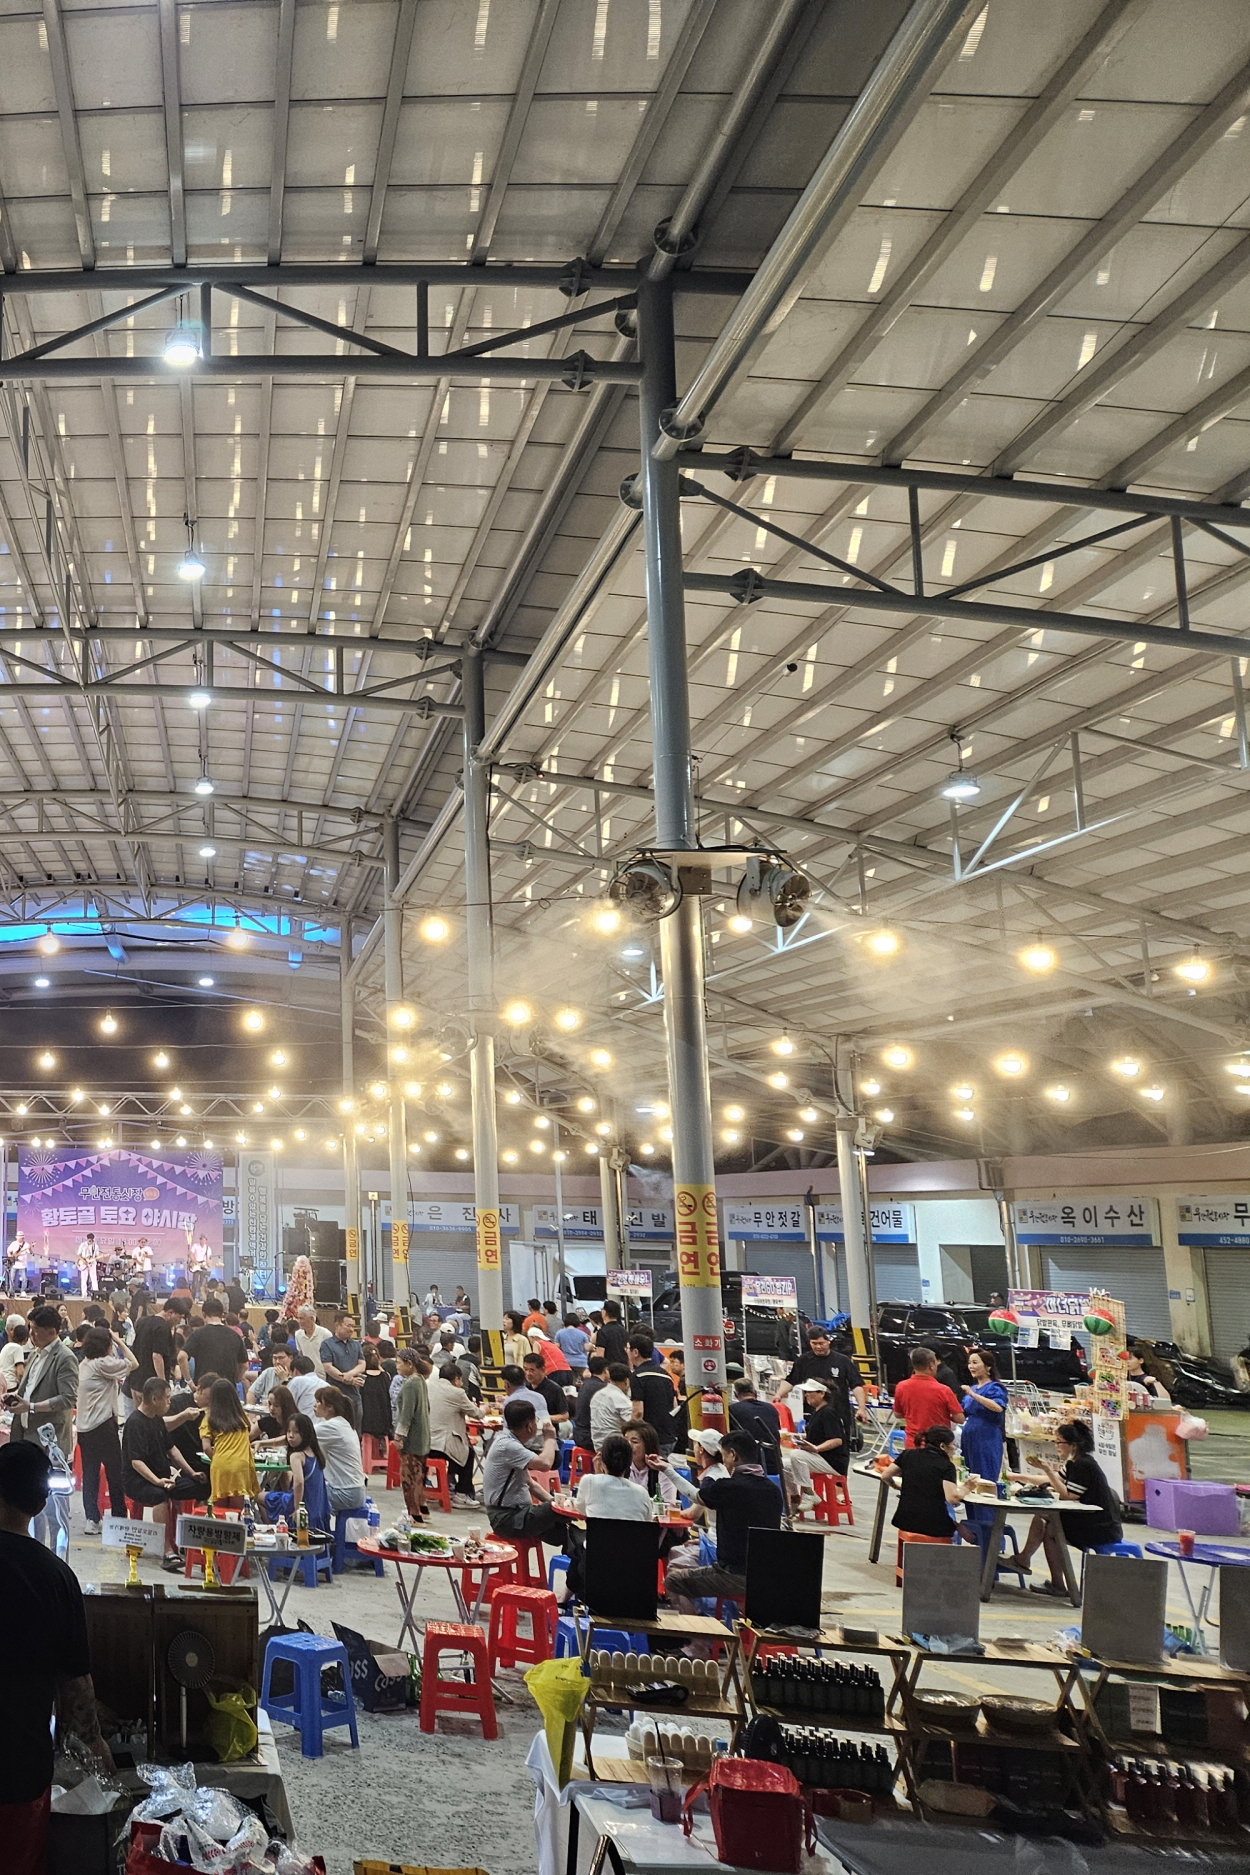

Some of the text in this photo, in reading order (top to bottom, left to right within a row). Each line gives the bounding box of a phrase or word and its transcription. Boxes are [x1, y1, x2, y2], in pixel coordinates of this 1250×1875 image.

[41, 1206, 198, 1231] 황토골 토요 야시장
[753, 1210, 801, 1229] 무안젓갈
[1060, 1204, 1145, 1228] 옥이수산
[484, 1231, 498, 1264] 금연
[678, 1221, 701, 1276] 금연
[694, 1338, 721, 1348] 소화기
